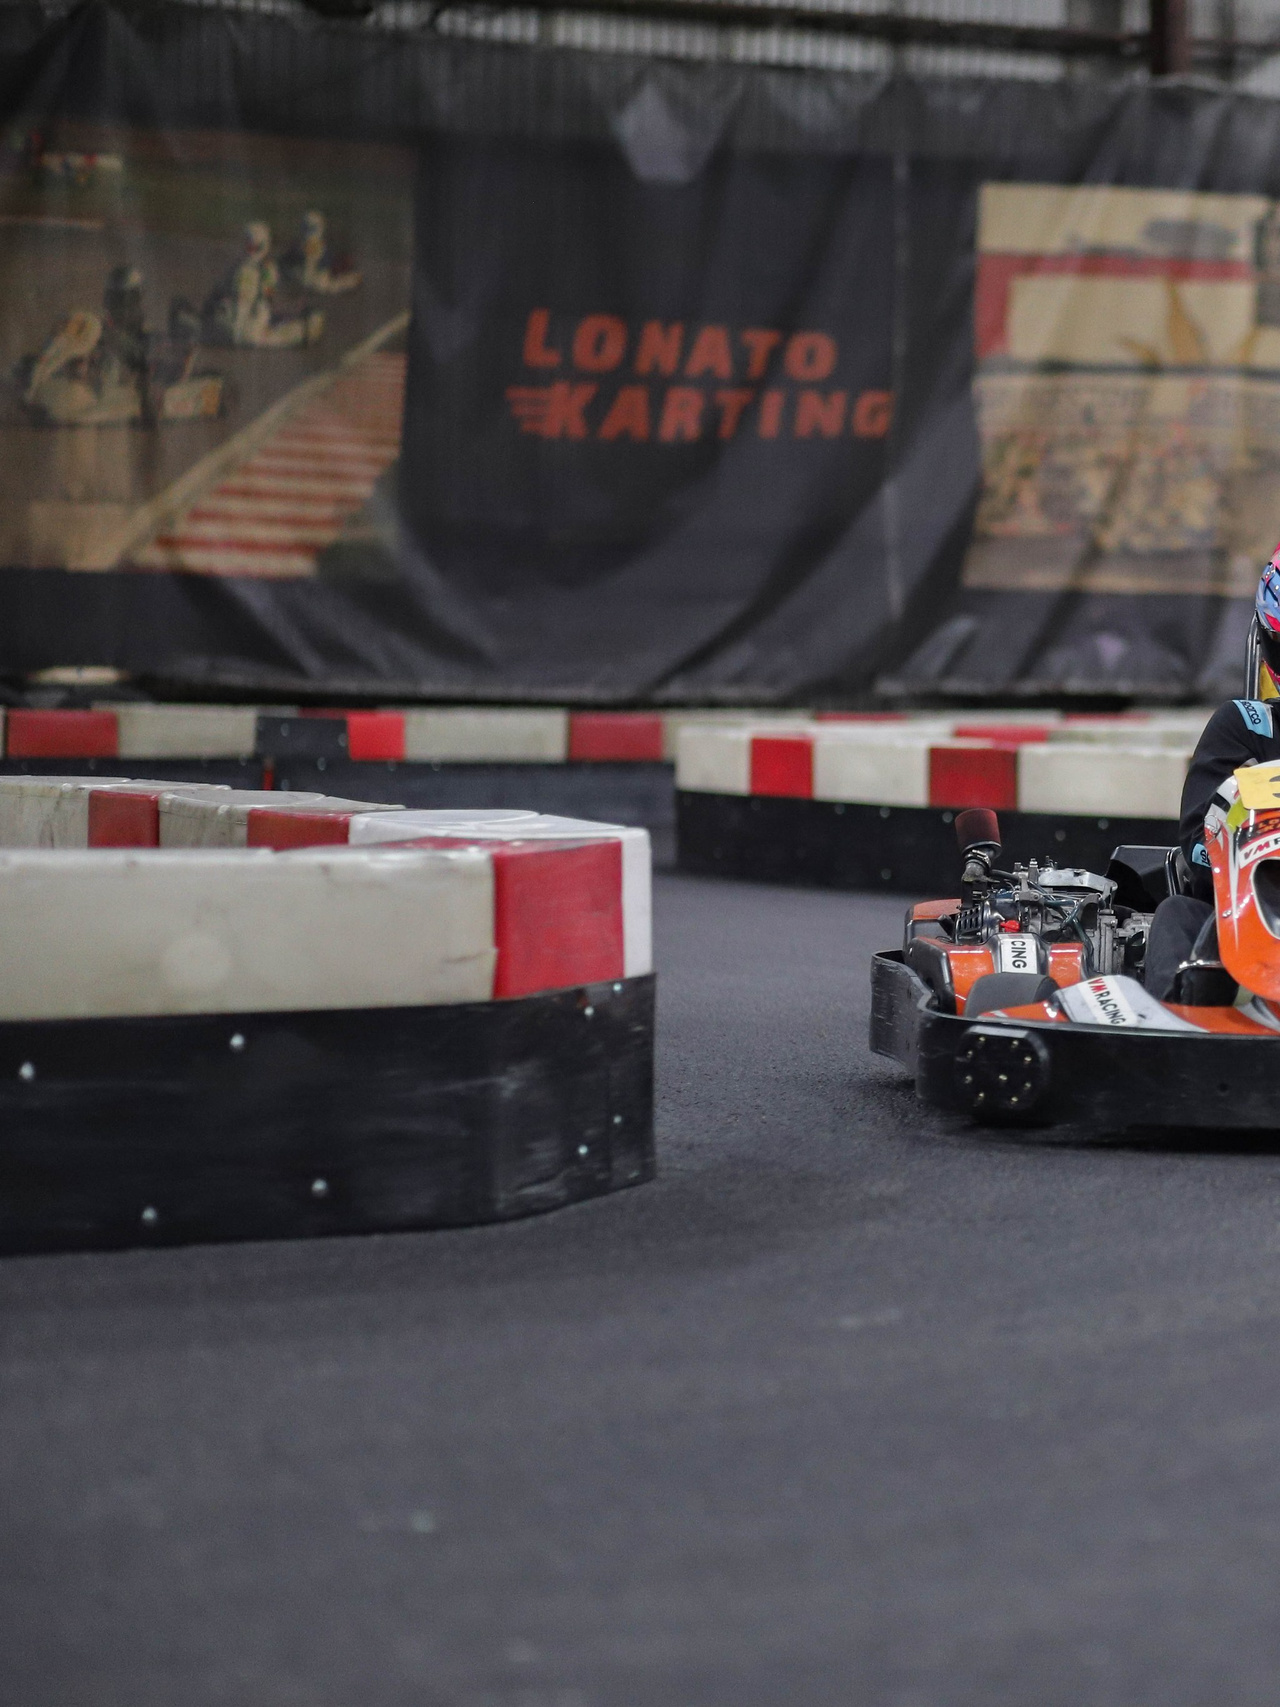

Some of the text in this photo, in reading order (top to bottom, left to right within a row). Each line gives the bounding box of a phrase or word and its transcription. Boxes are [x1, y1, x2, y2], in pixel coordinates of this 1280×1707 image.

[522, 307, 839, 383] LONATO
[530, 380, 898, 443] KARTING
[1088, 977, 1127, 1026] VMRACING
